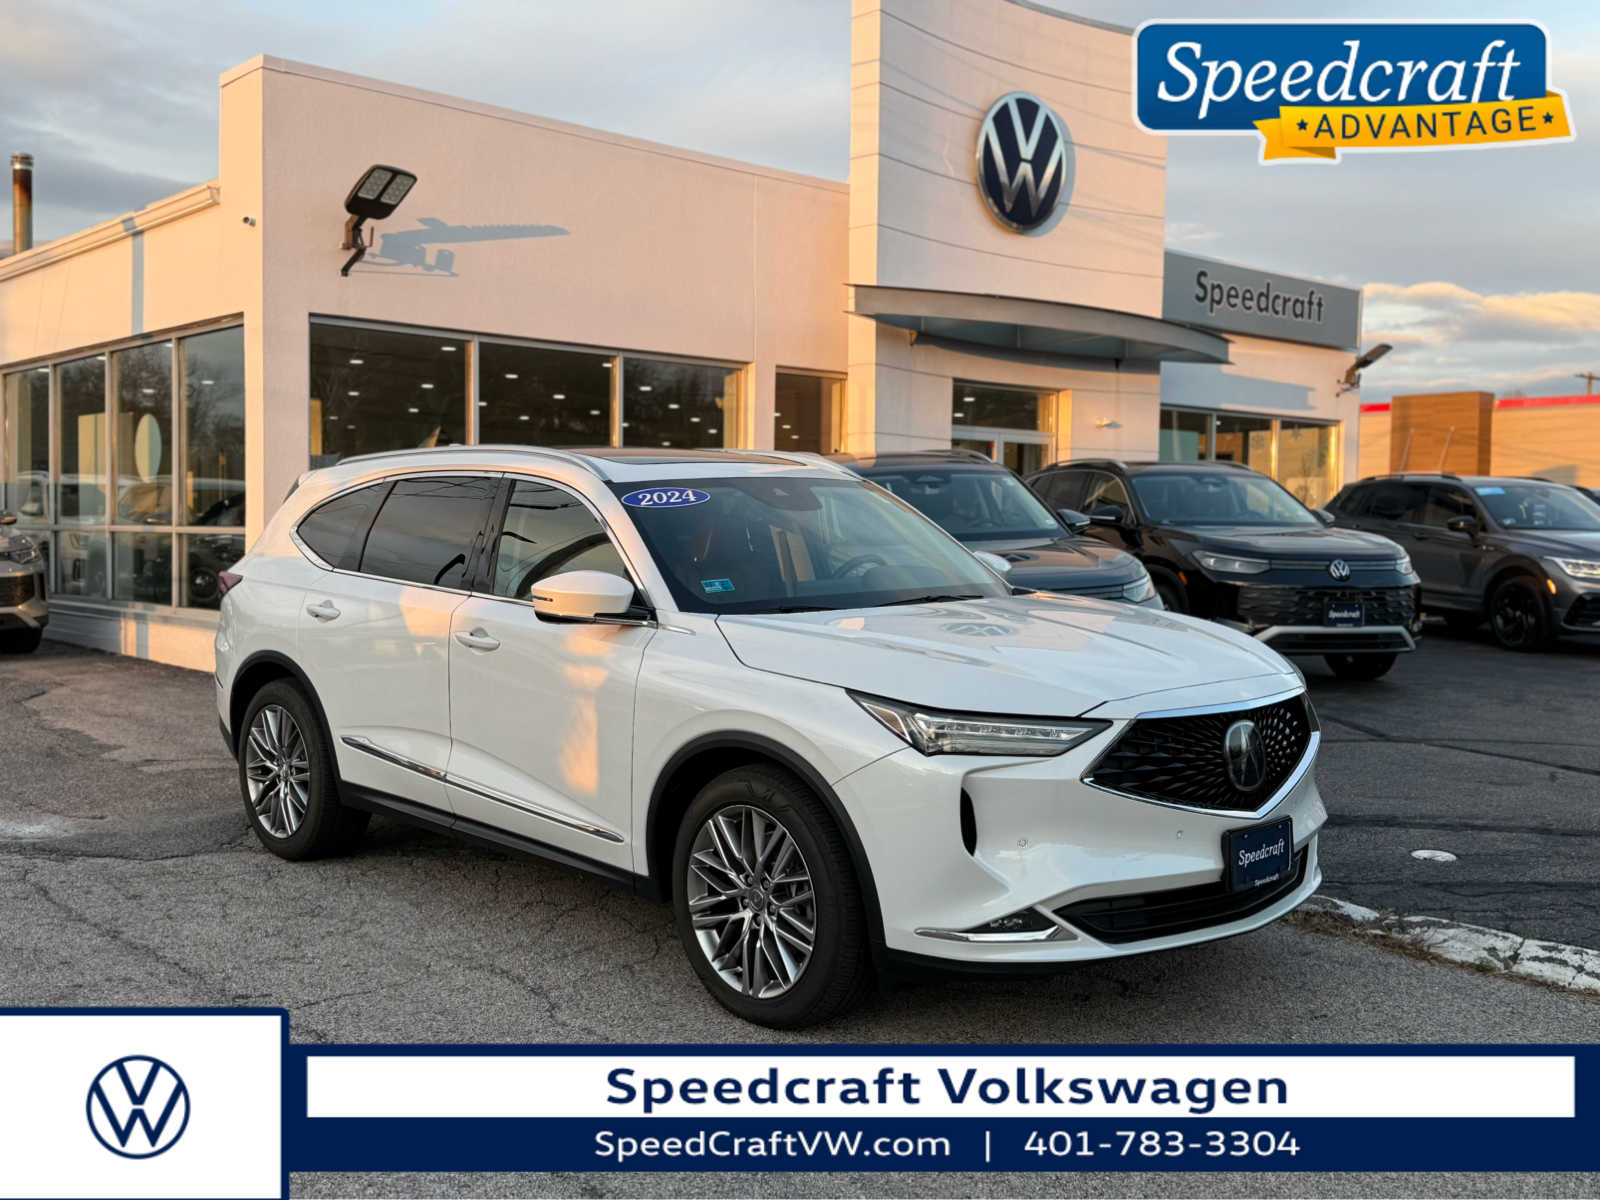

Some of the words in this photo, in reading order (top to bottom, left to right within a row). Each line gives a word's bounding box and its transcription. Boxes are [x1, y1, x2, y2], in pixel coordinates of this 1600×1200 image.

[1195, 270, 1324, 322] Speedcraft
[637, 489, 697, 507] 2024
[1238, 838, 1285, 868] Speedcraft
